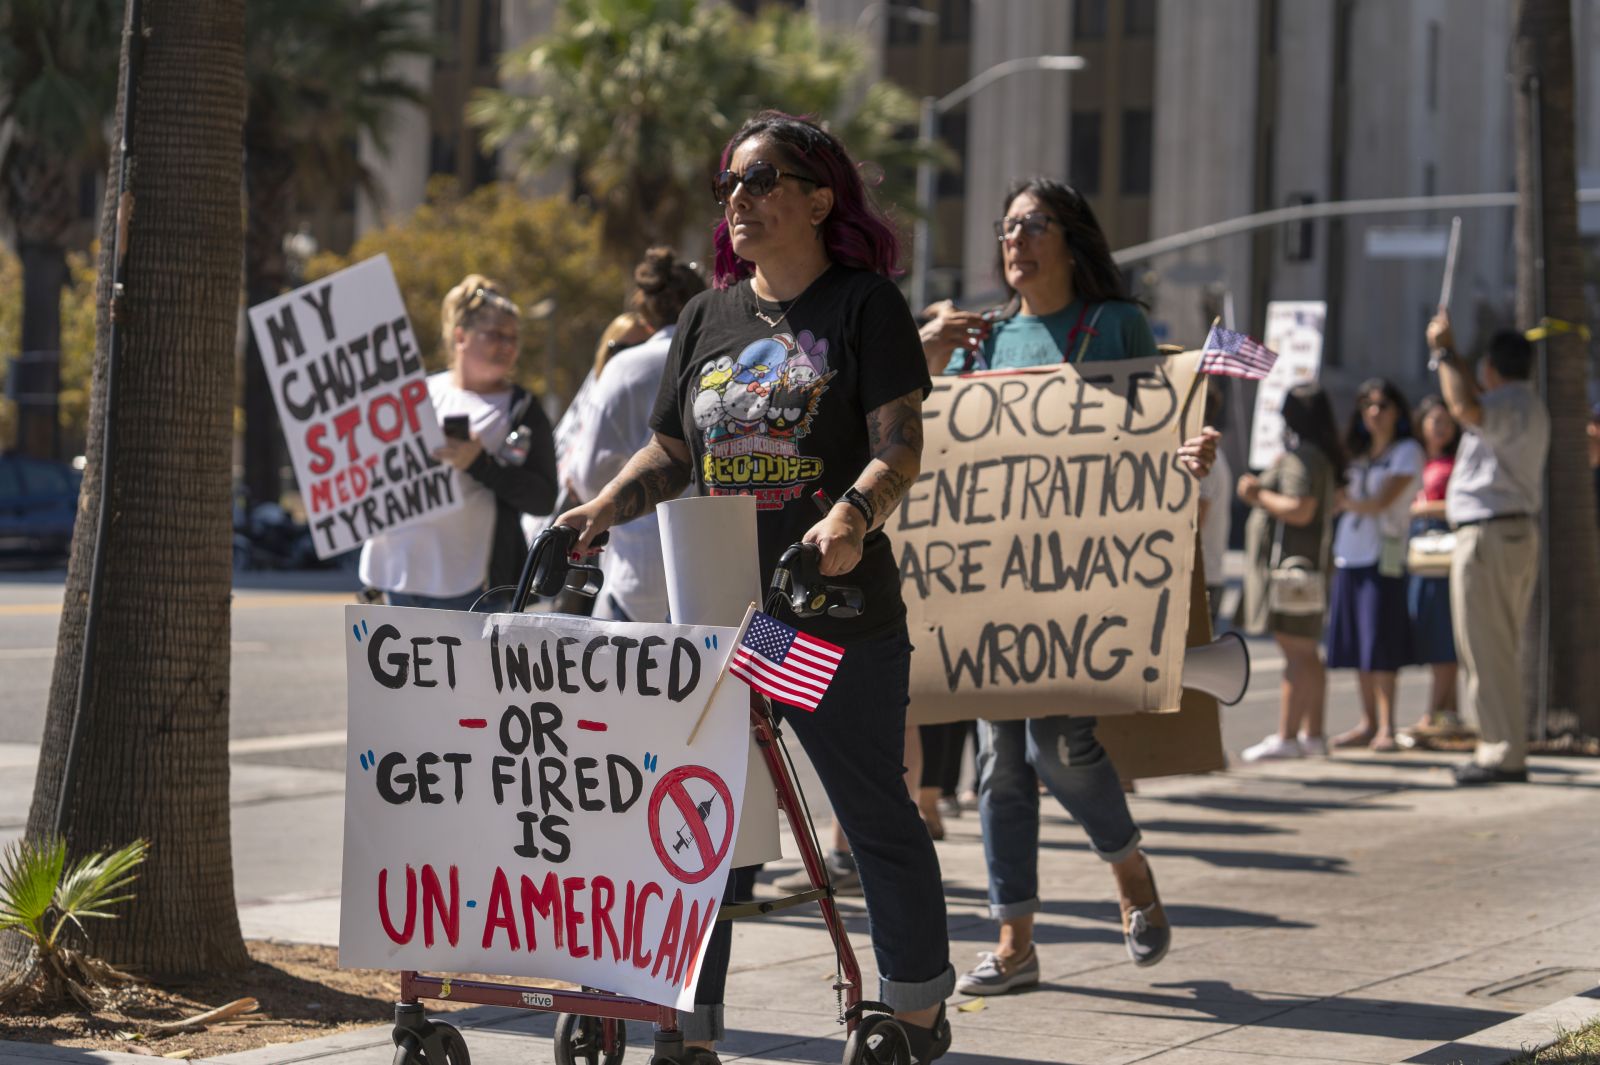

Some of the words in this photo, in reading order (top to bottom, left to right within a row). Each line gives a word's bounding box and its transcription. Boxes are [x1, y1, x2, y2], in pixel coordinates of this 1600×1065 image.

[265, 284, 336, 367] MY
[281, 315, 422, 422] CHOICE
[306, 380, 428, 475] STOP
[310, 436, 445, 513] MEDICAL
[315, 465, 455, 550] TYRANNY
[898, 451, 1193, 532] ENETRATIONS
[900, 541, 992, 600] ARE
[1001, 530, 1175, 593] ALWAYS
[353, 619, 462, 689] "GET
[491, 624, 718, 703] INJECTED"
[938, 589, 1170, 693] WRONG!
[360, 750, 472, 805] "GET
[492, 752, 658, 814] FIRED"
[513, 811, 571, 863] IS
